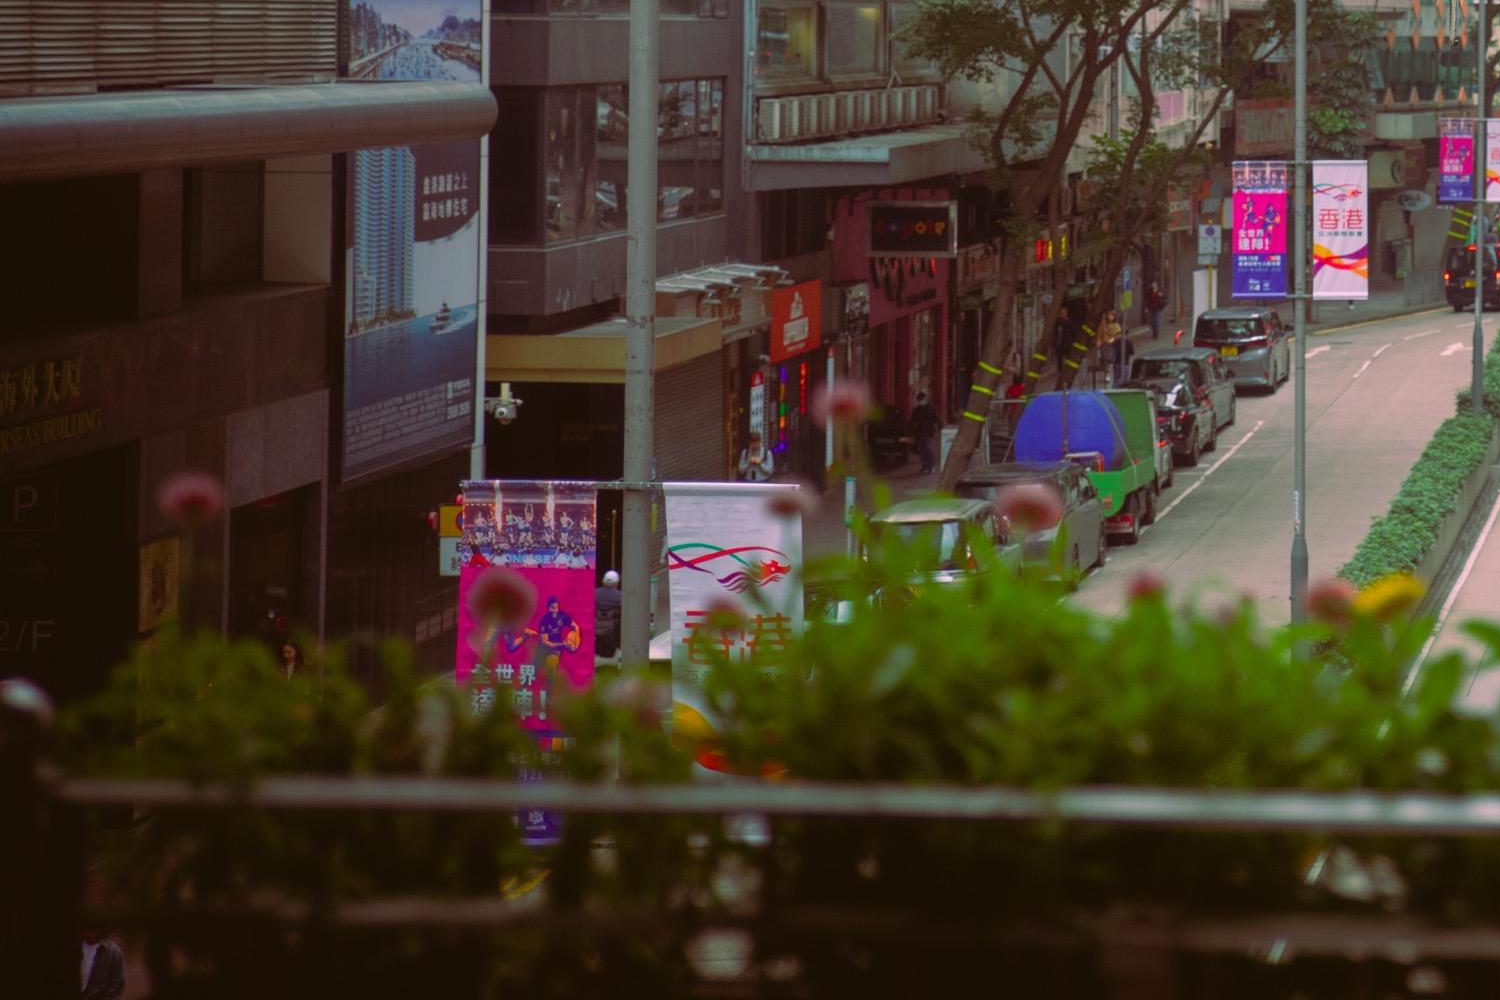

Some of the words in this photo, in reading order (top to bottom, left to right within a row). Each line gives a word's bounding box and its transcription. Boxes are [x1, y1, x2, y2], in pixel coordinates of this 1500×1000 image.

[1319, 208, 1363, 229] 香港
[470, 663, 537, 686] 全世界
